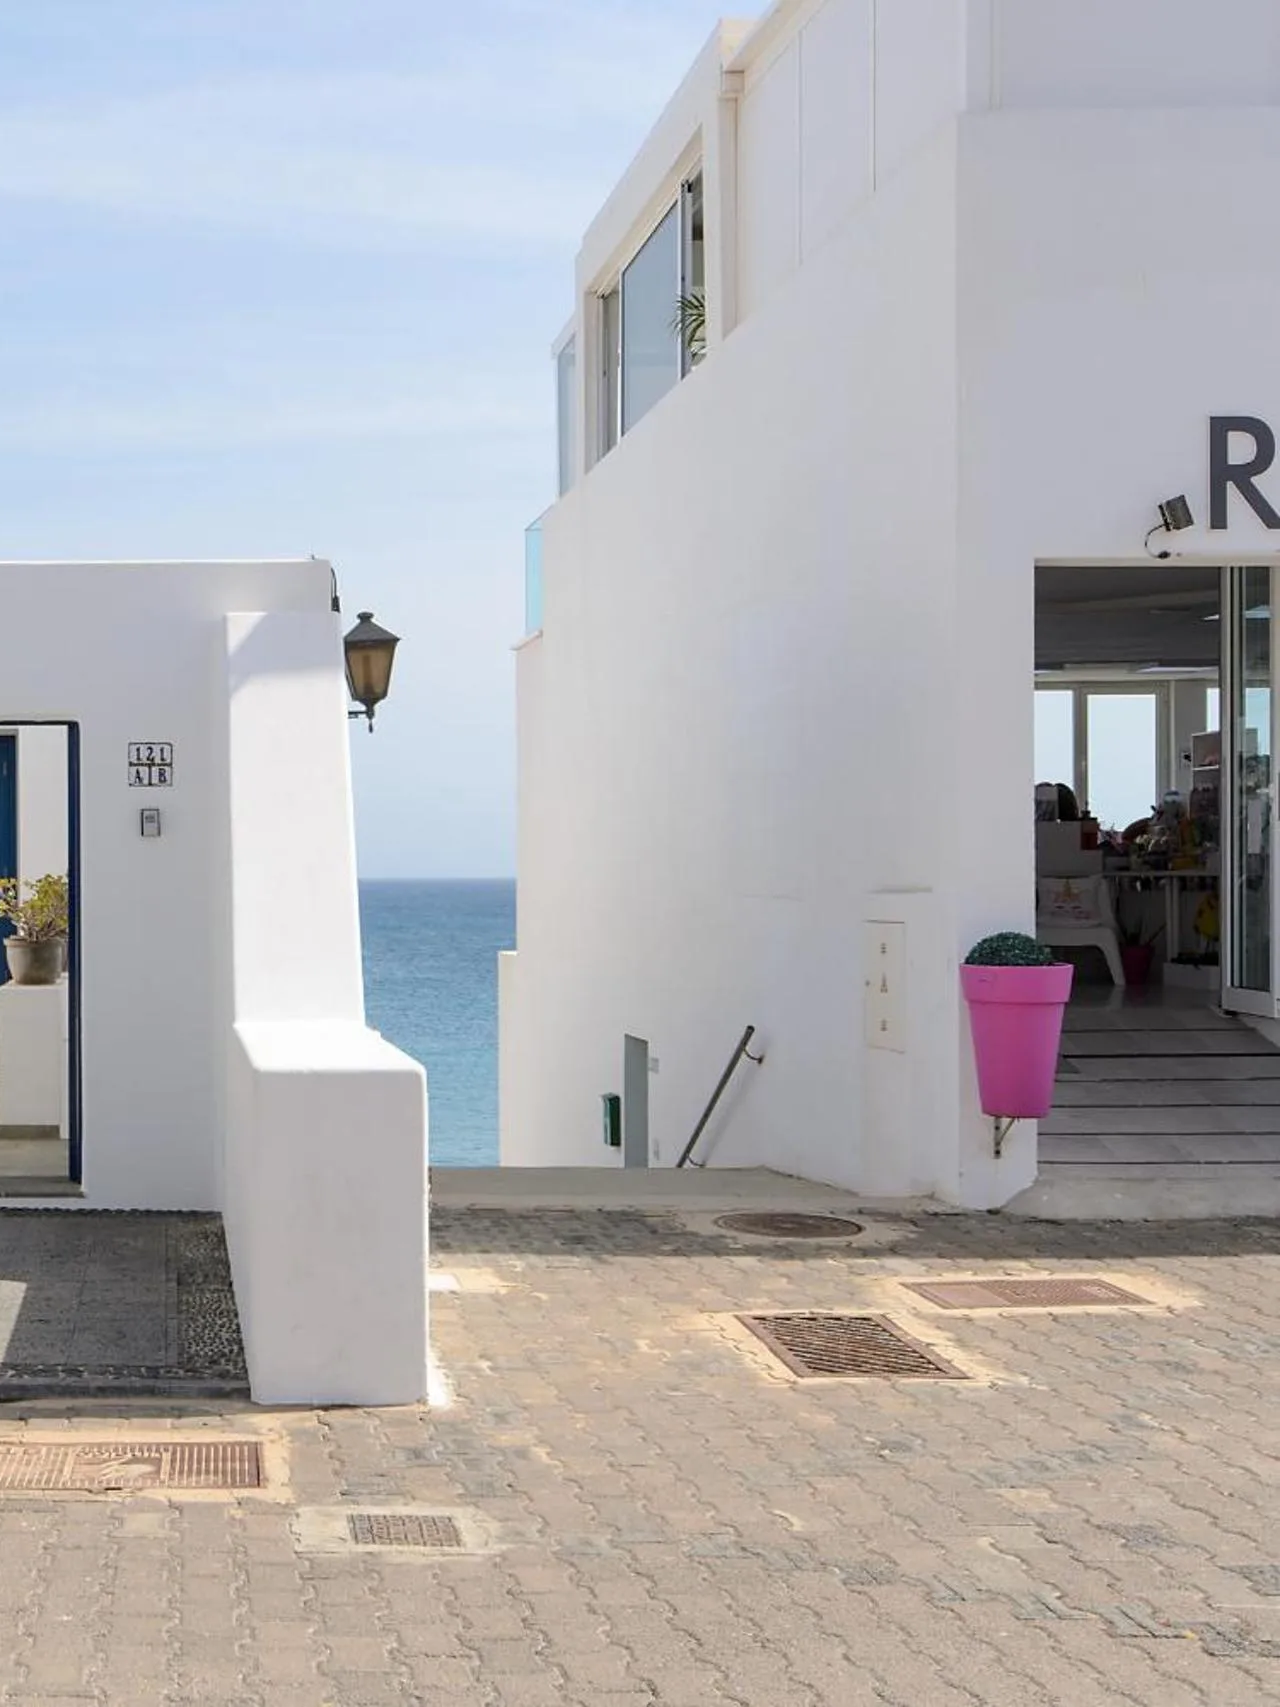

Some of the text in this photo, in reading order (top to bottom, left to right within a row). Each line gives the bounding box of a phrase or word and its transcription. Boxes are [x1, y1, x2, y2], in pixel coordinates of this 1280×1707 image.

[1210, 416, 1280, 529] R
[135, 746, 167, 762] 121
[134, 768, 167, 784] A B
